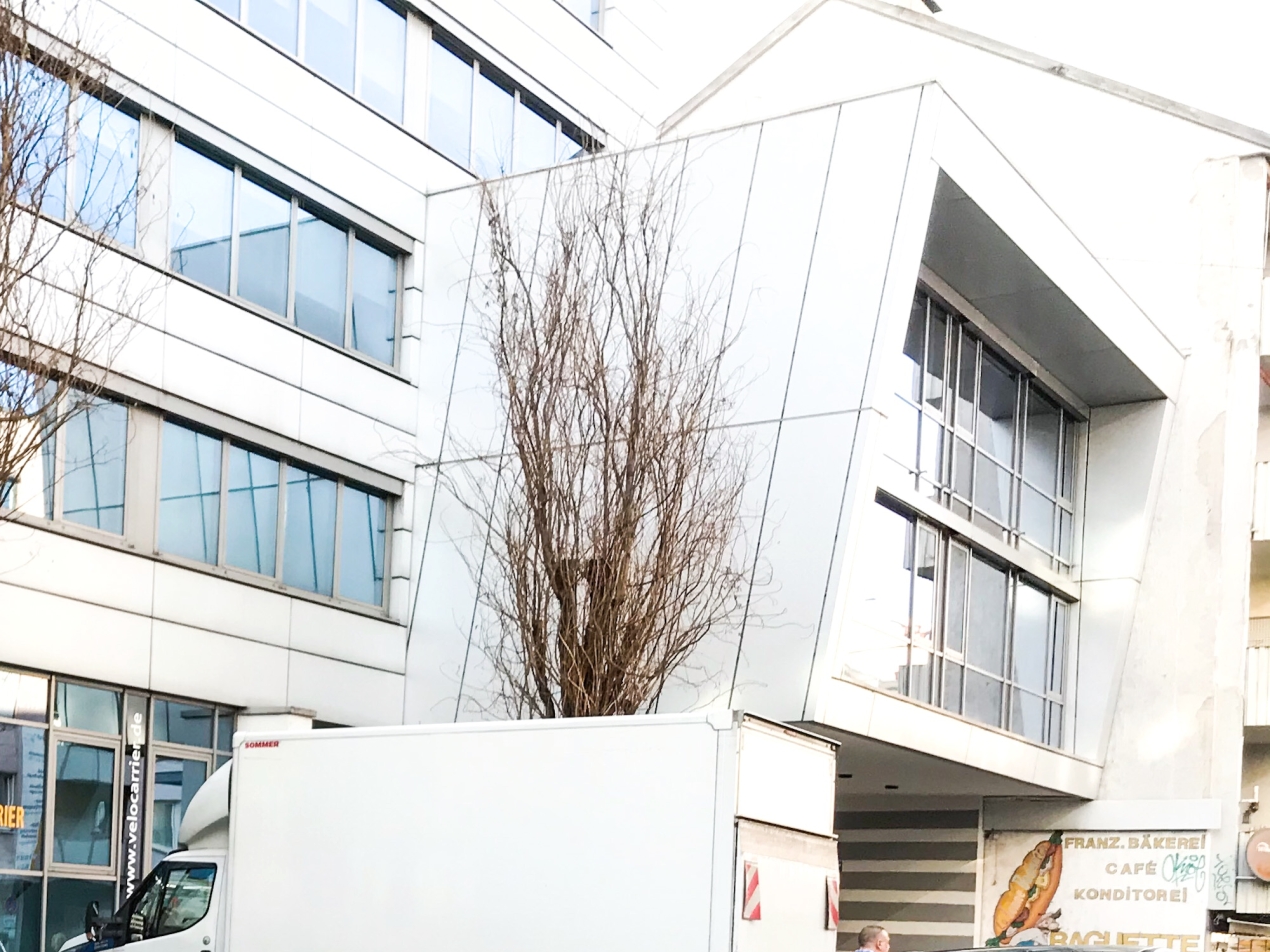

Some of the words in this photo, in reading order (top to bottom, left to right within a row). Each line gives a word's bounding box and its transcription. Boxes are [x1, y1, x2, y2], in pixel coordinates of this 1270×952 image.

[244, 740, 280, 748] SOMMER
[1064, 836, 1125, 850] FRANZ.
[1105, 860, 1157, 875] CAFÉ
